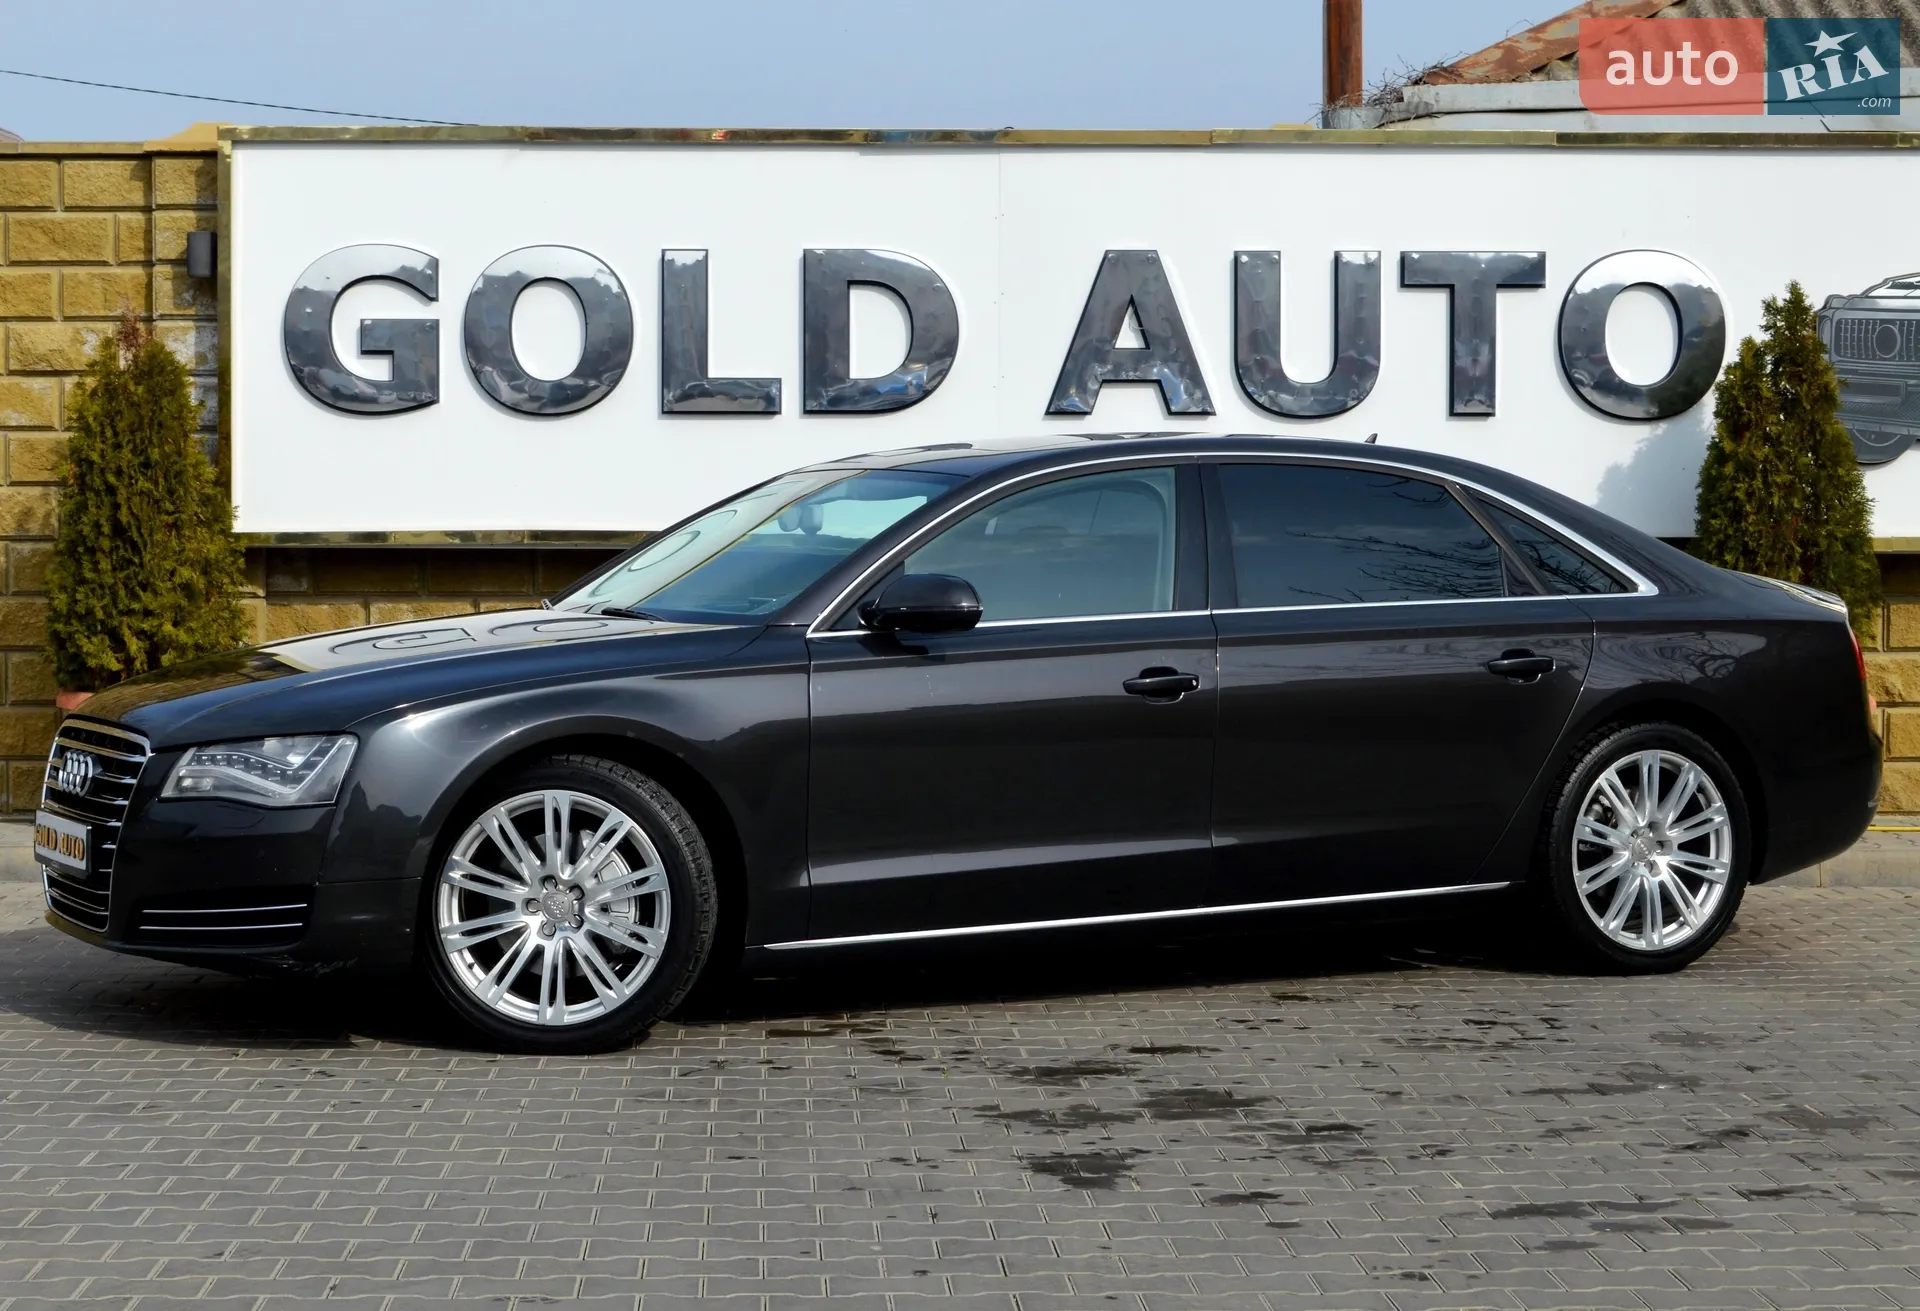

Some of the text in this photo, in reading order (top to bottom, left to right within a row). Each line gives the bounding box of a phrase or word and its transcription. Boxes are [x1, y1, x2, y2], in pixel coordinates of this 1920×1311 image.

[283, 243, 1726, 420] GOLD AUTO
[35, 823, 85, 861] GOLD AUTO
